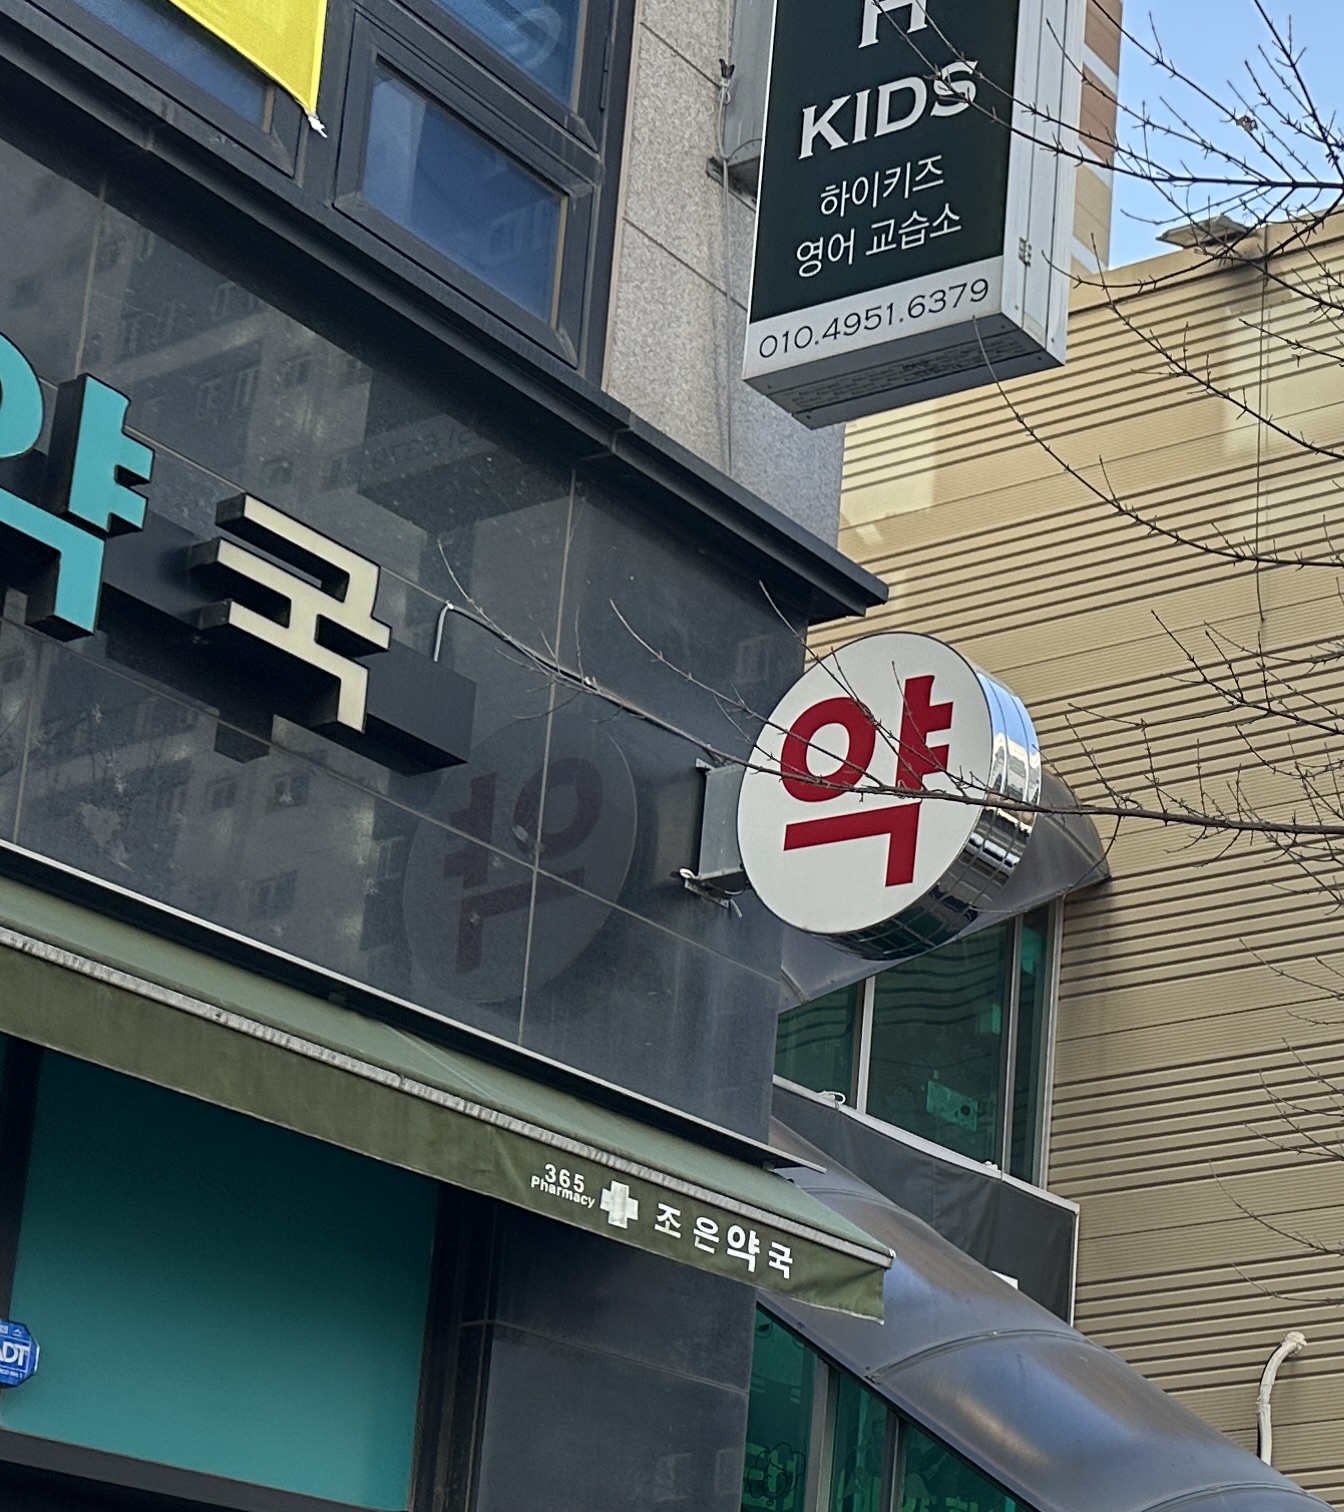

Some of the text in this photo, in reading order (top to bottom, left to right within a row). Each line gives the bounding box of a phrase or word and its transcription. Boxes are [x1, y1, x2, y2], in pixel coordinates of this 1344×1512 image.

[799, 60, 978, 160] KIDS
[820, 155, 944, 218] 하이키즈
[796, 203, 962, 278] 영어 교습소
[758, 278, 989, 359] 010.4951.6379
[782, 672, 952, 888] 약
[530, 1175, 596, 1208] Pharmacy
[544, 1163, 585, 1193] 365
[654, 1202, 793, 1280] 조은약국
